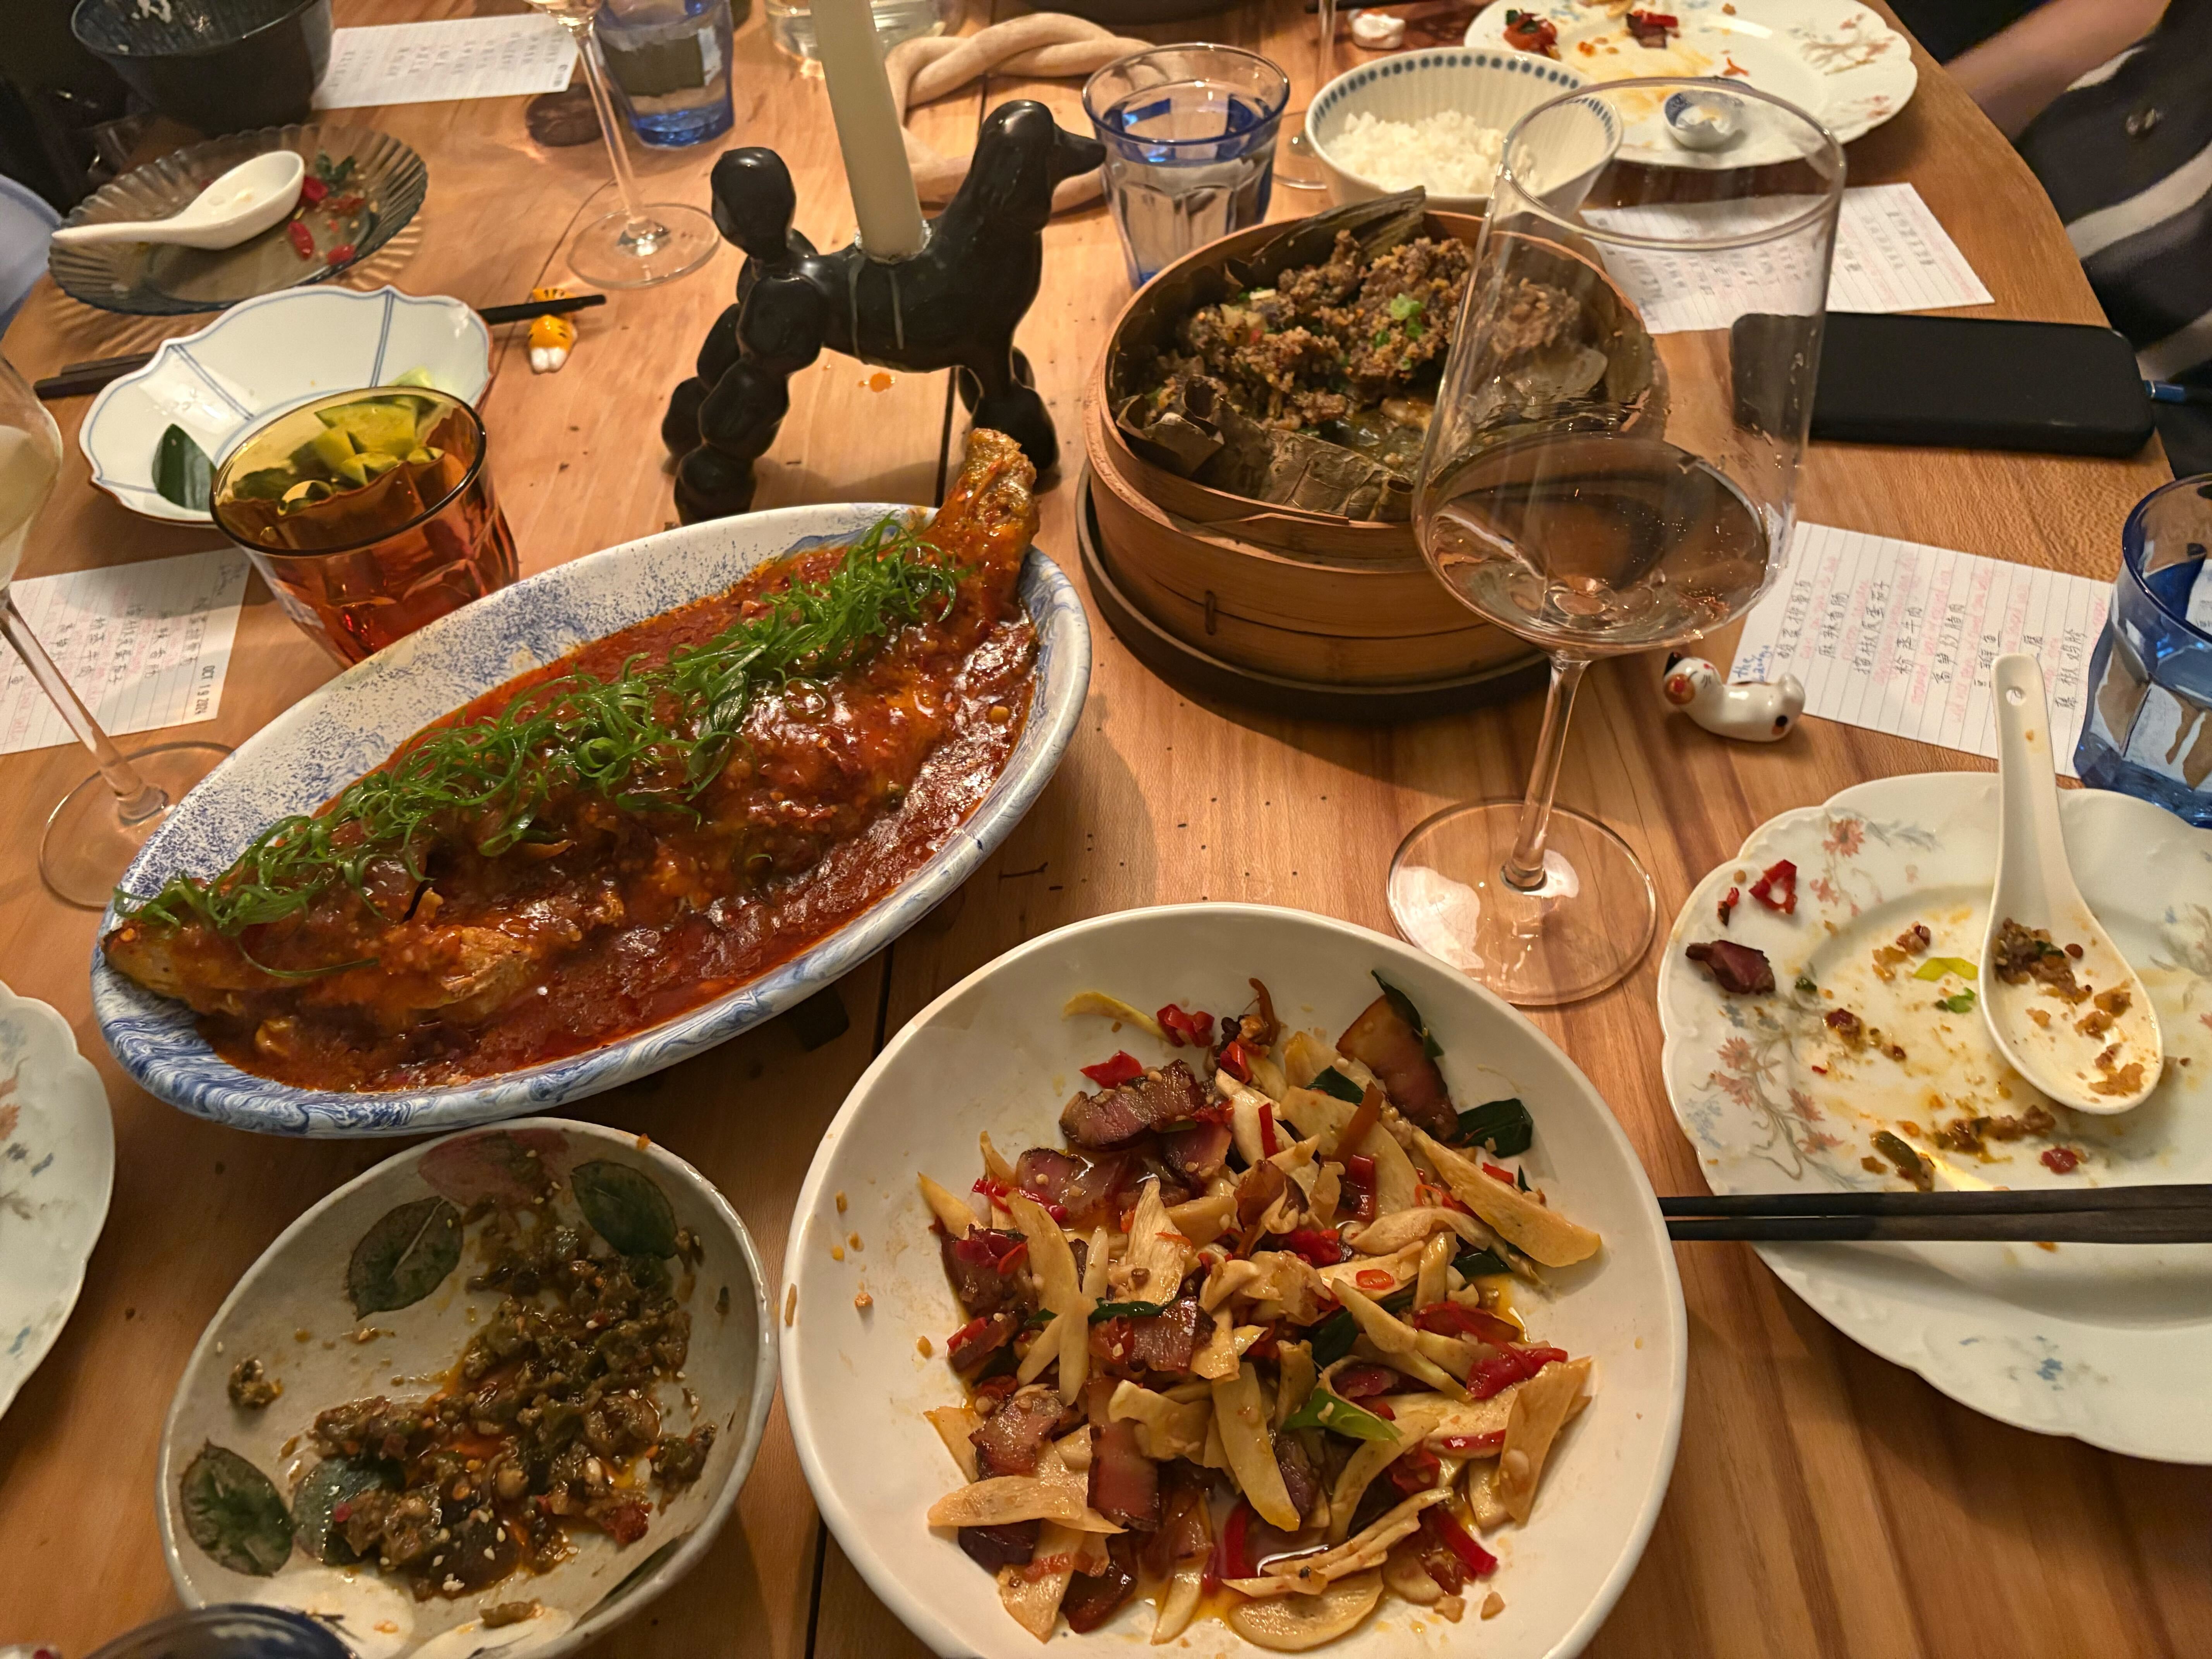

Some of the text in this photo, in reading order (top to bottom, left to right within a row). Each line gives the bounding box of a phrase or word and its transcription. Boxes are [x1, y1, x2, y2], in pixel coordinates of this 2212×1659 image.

[1819, 592, 1849, 659] 麻辣香肠
[1893, 607, 1922, 674] 粉蒸牛肉
[201, 665, 216, 679] OCT
[1974, 630, 2001, 689] 豆瓣鱼
[197, 684, 211, 696] 19
